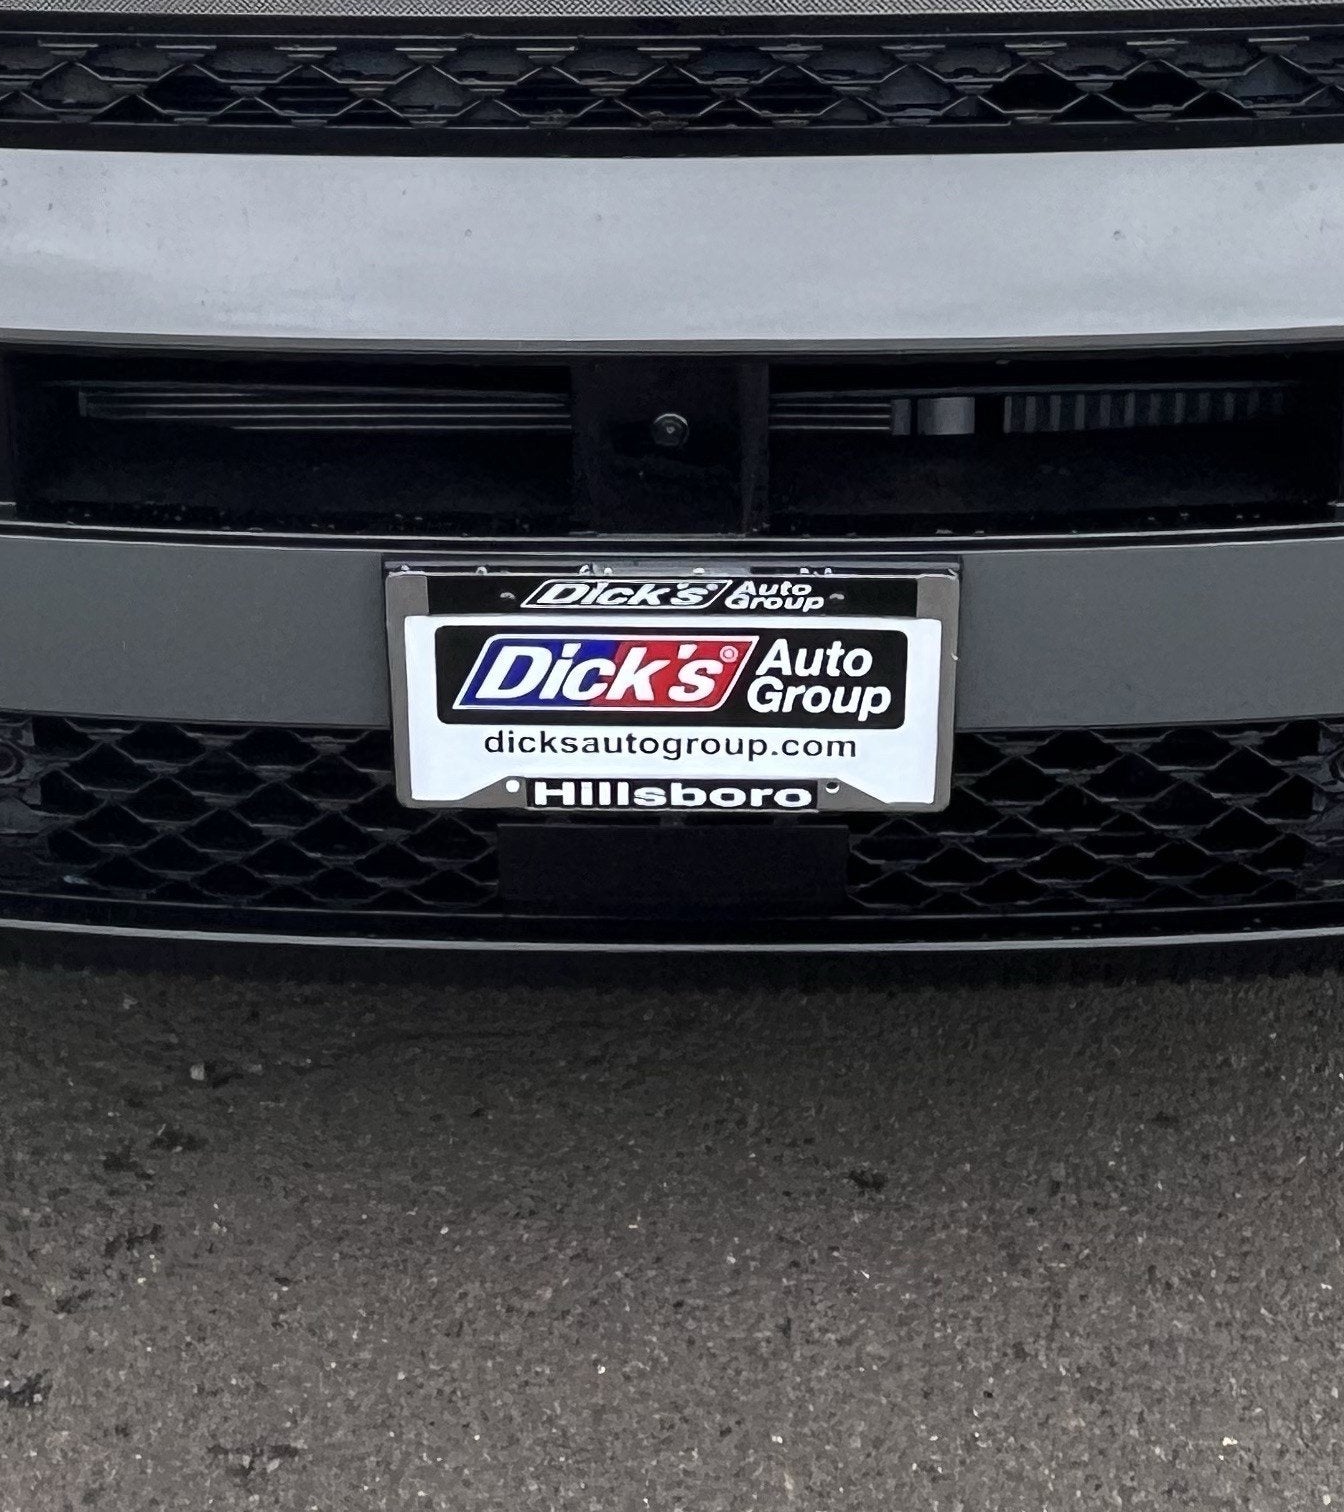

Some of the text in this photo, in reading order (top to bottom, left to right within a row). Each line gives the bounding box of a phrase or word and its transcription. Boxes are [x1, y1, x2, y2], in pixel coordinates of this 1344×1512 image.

[535, 580, 812, 606] Dick's Auto
[725, 594, 825, 612] Group
[474, 638, 873, 703] Dick's Auto
[747, 678, 892, 722] Group
[484, 729, 857, 762] dicksautogroup.com
[533, 780, 814, 809] Hillsboro
